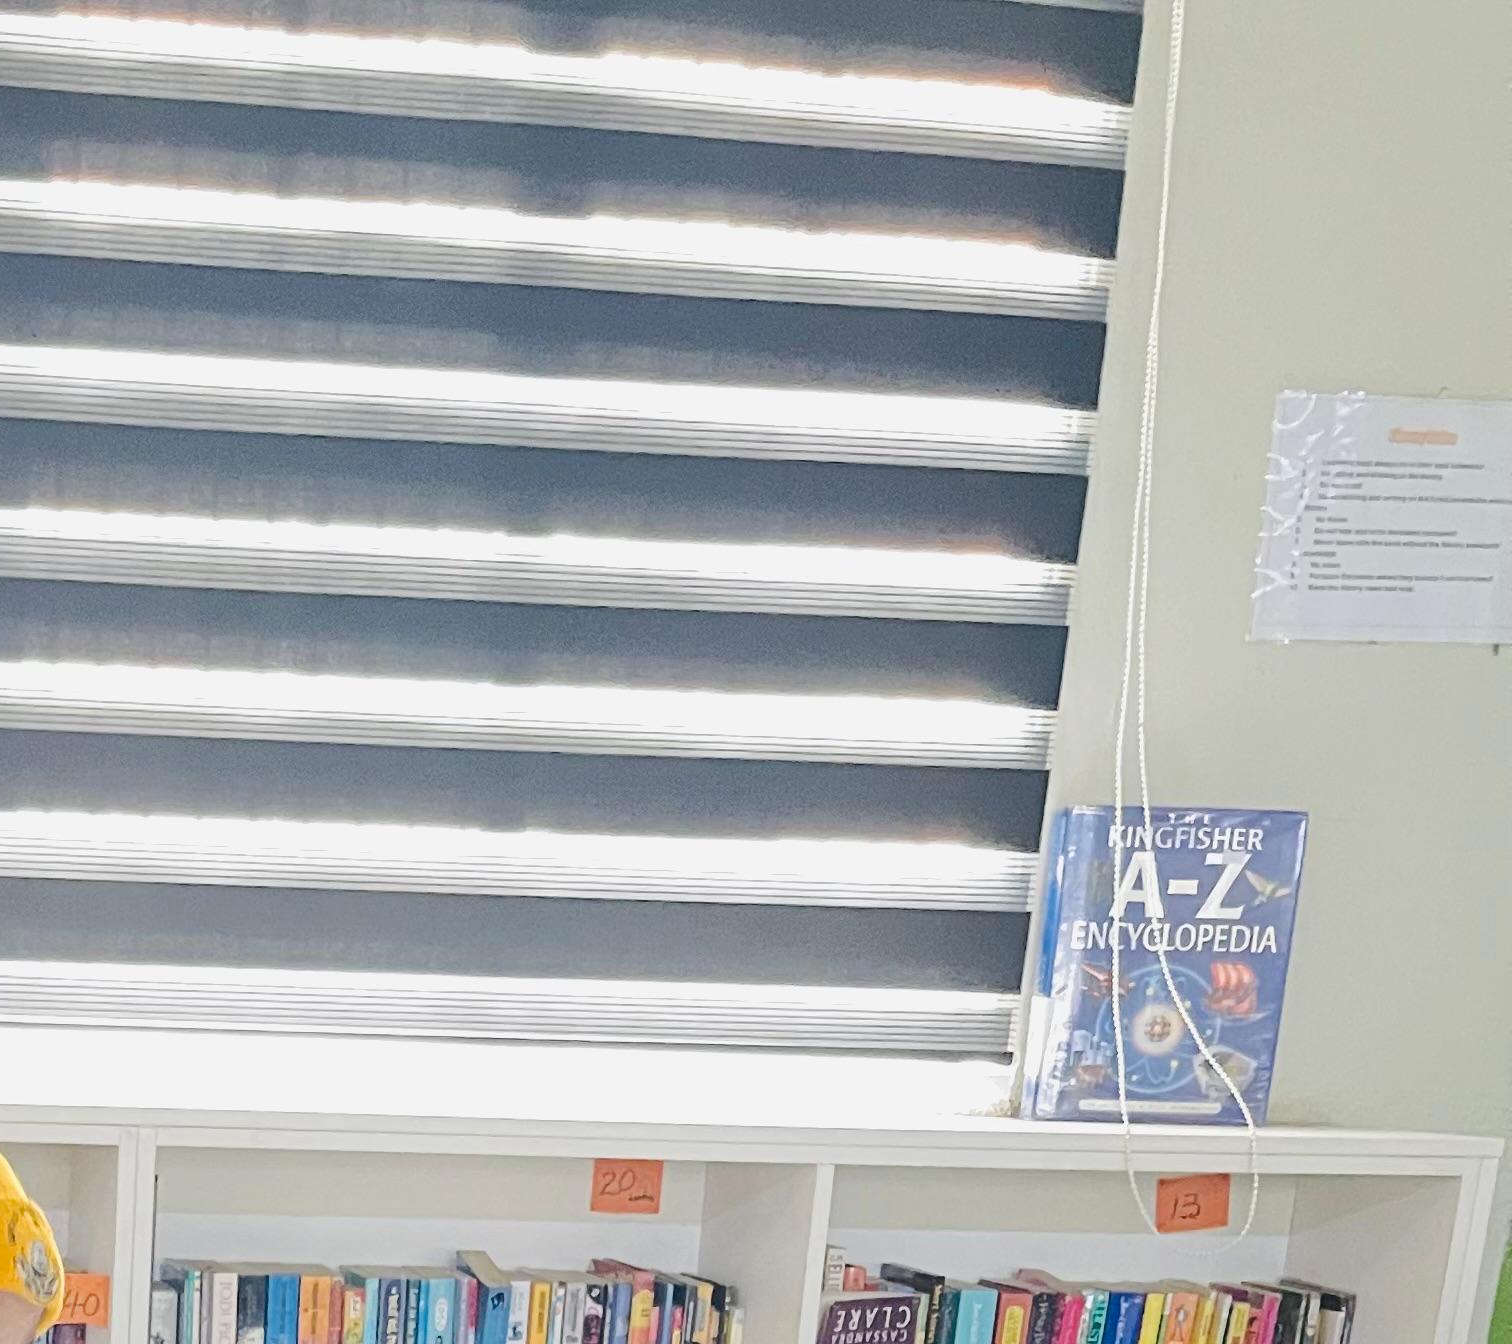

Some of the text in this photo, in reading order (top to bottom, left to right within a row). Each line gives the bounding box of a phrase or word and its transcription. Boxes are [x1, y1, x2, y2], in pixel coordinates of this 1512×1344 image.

[1108, 825, 1264, 850] KINGFISHER
[1108, 850, 1253, 919] A-Z
[1070, 920, 1277, 953] ENCYCLOPEDIA
[599, 1168, 636, 1196] 20
[1171, 1193, 1201, 1219] 13
[833, 1306, 911, 1332] CLARE
